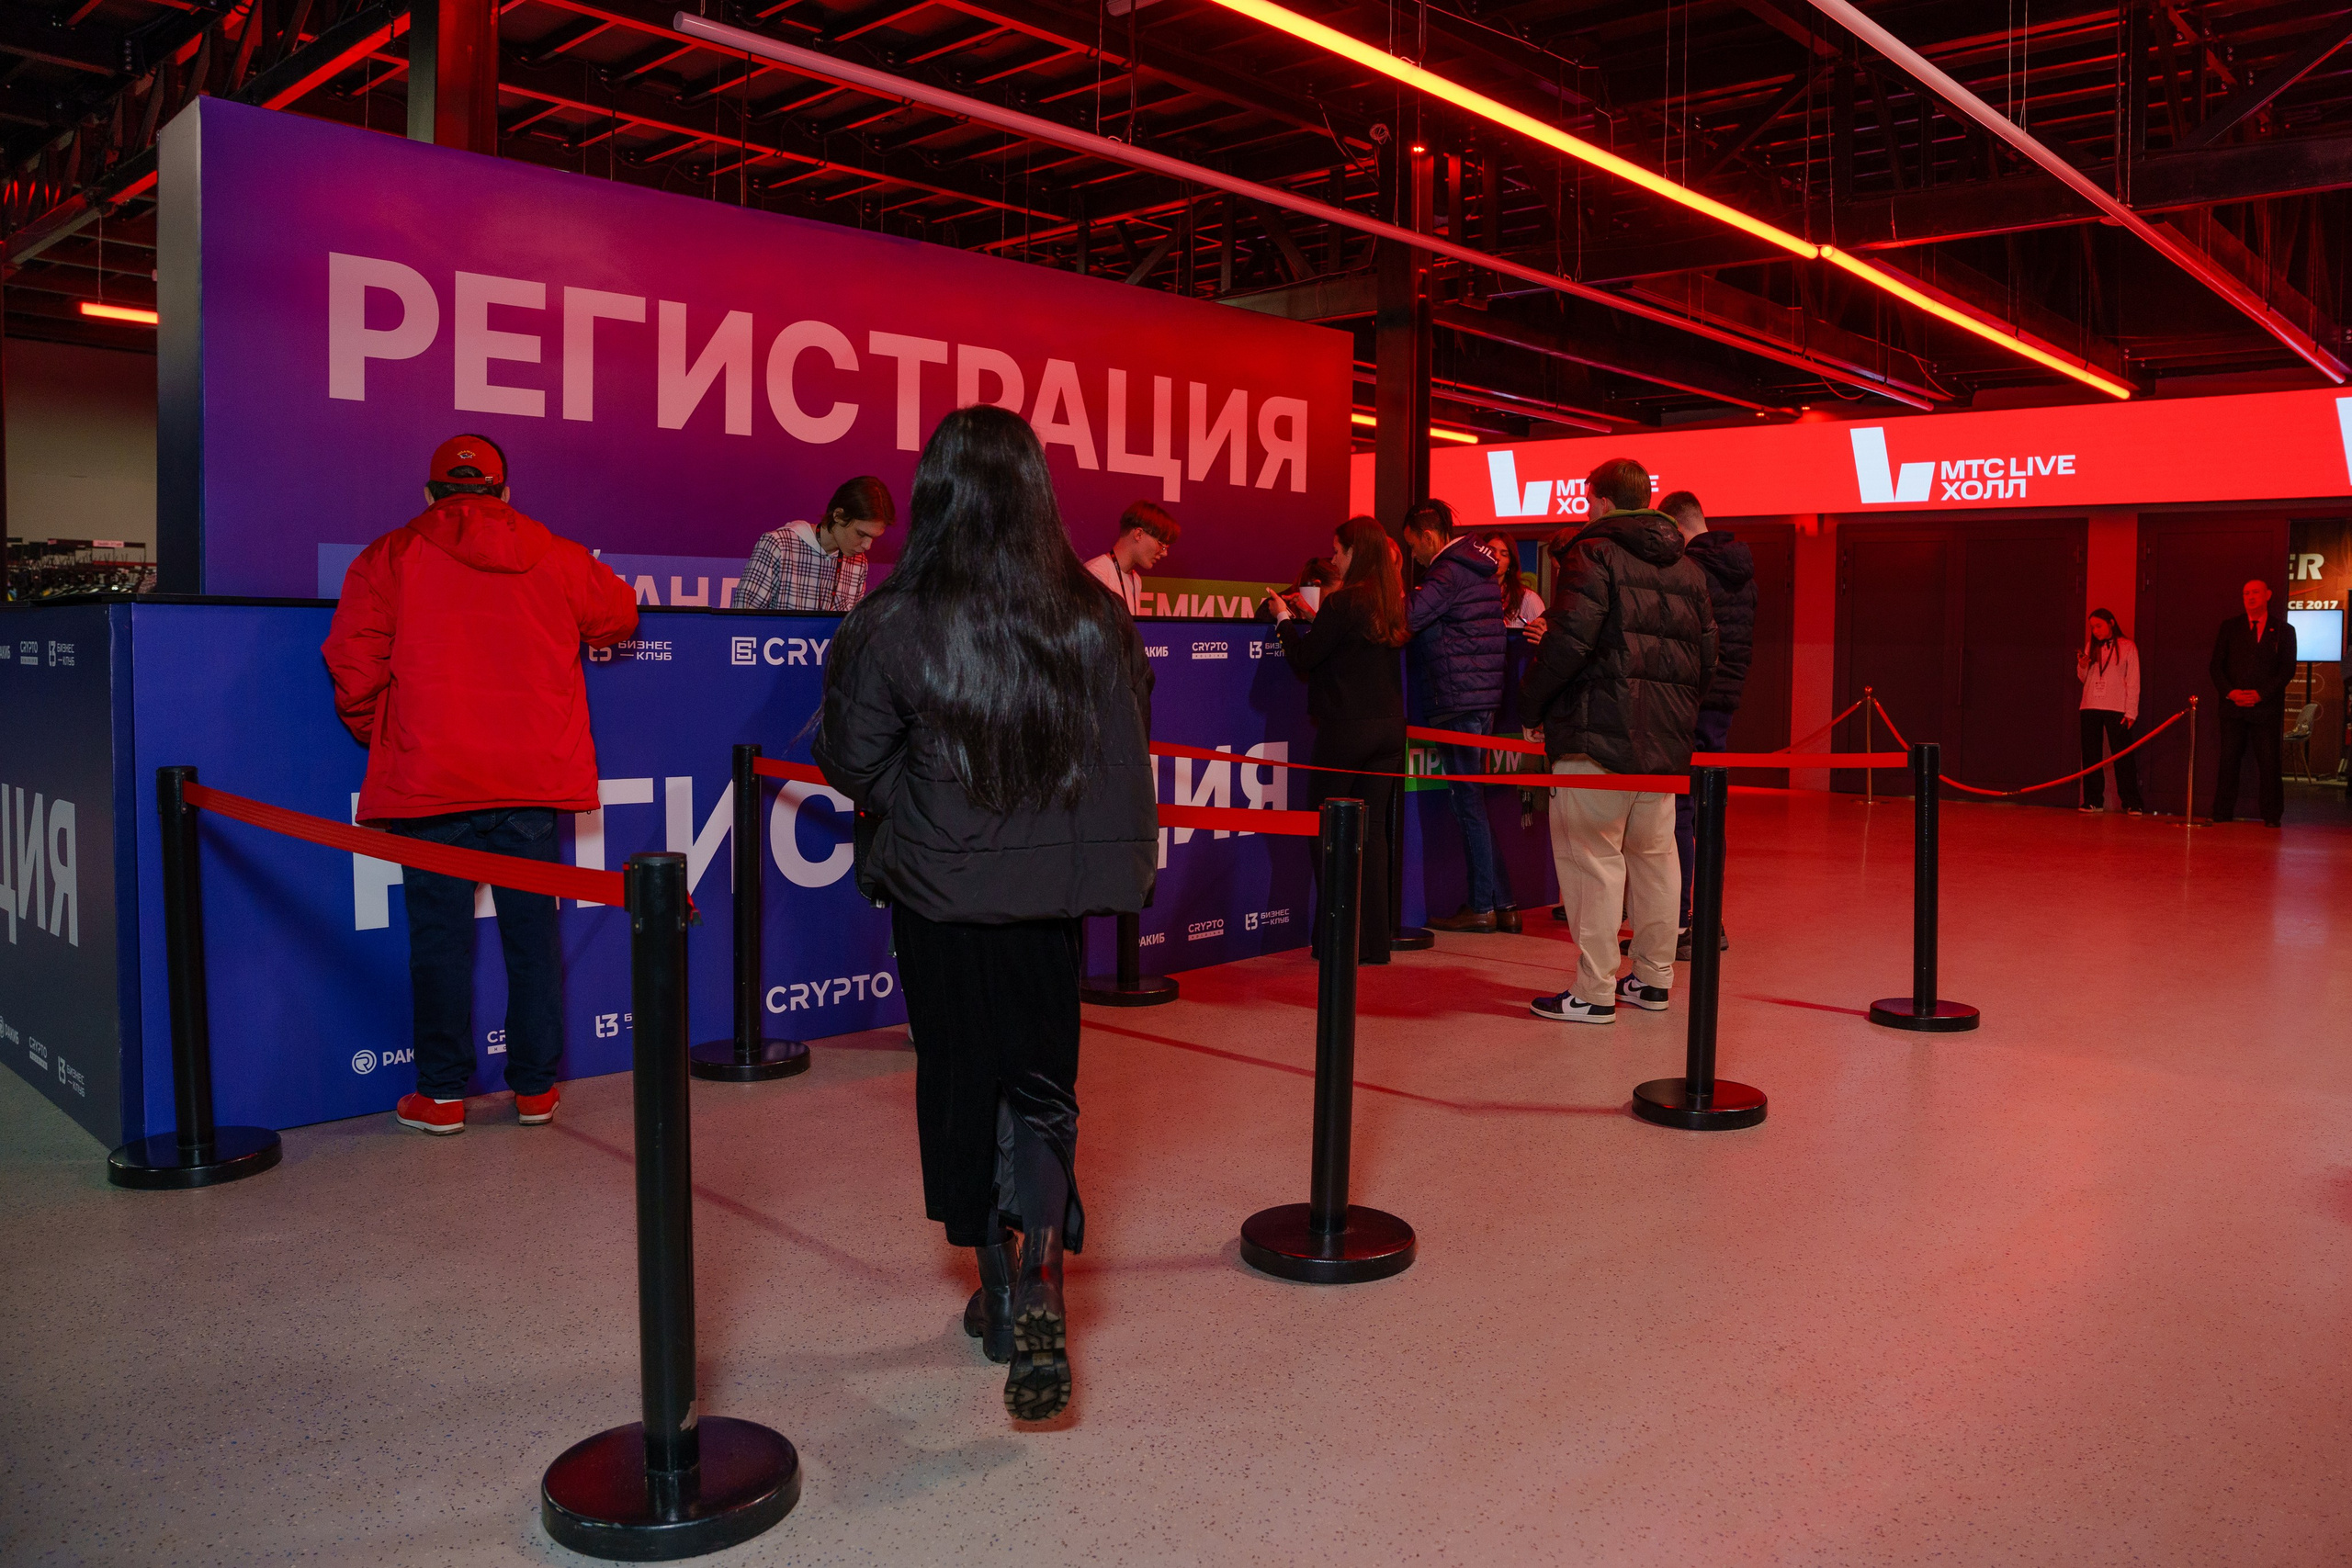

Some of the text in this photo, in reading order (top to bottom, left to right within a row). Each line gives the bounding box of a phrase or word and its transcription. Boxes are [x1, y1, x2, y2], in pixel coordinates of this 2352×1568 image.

[1940, 454, 2075, 479] МТС LIVE
[1556, 479, 1587, 496] МТ
[1940, 479, 2026, 501] ХОЛЛ
[1556, 497, 1590, 514] ХО
[2305, 600, 2339, 610] 2017
[20, 641, 39, 653] CRYPTO
[1192, 641, 1228, 651] CRYPTO
[1261, 908, 1290, 919] БИЗНЕС
[1188, 919, 1225, 933] CRYPTO
[765, 971, 894, 1014] CRYPTO
